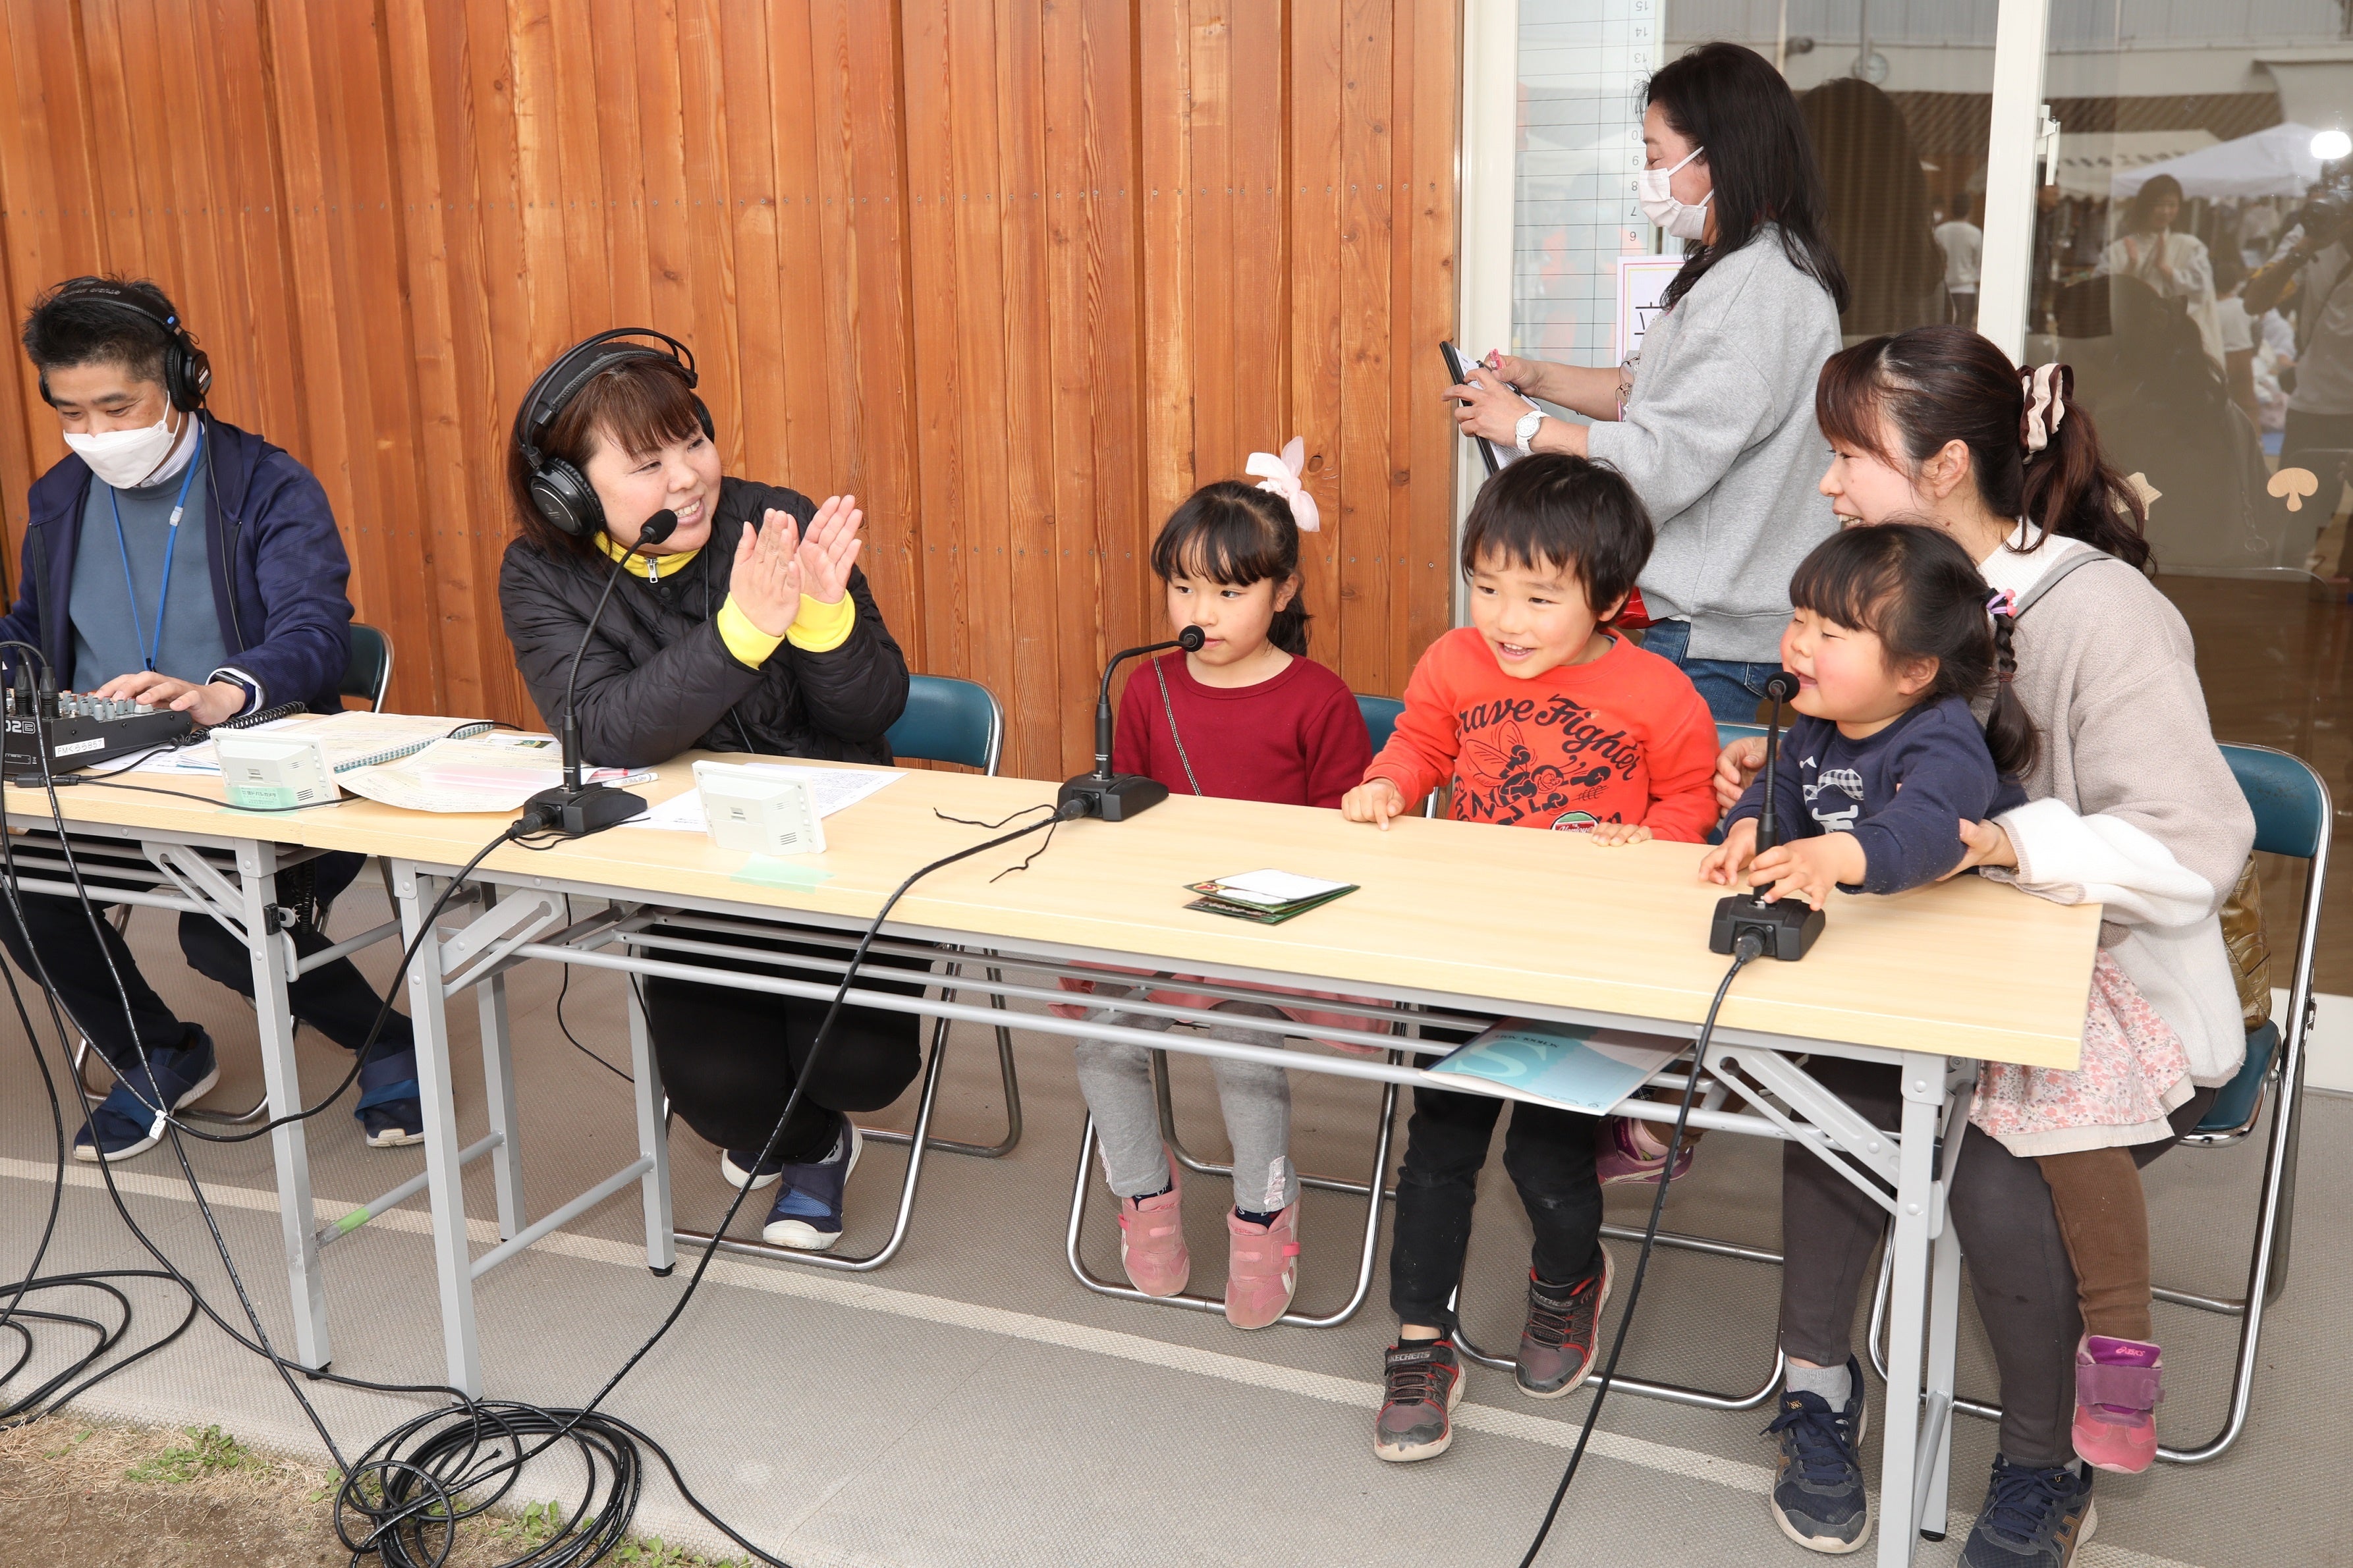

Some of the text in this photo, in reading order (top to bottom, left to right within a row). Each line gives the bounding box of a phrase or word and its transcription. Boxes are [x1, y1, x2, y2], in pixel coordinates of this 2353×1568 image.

[1631, 180, 1638, 191] 8
[1456, 693, 1641, 781] rave Fighter
